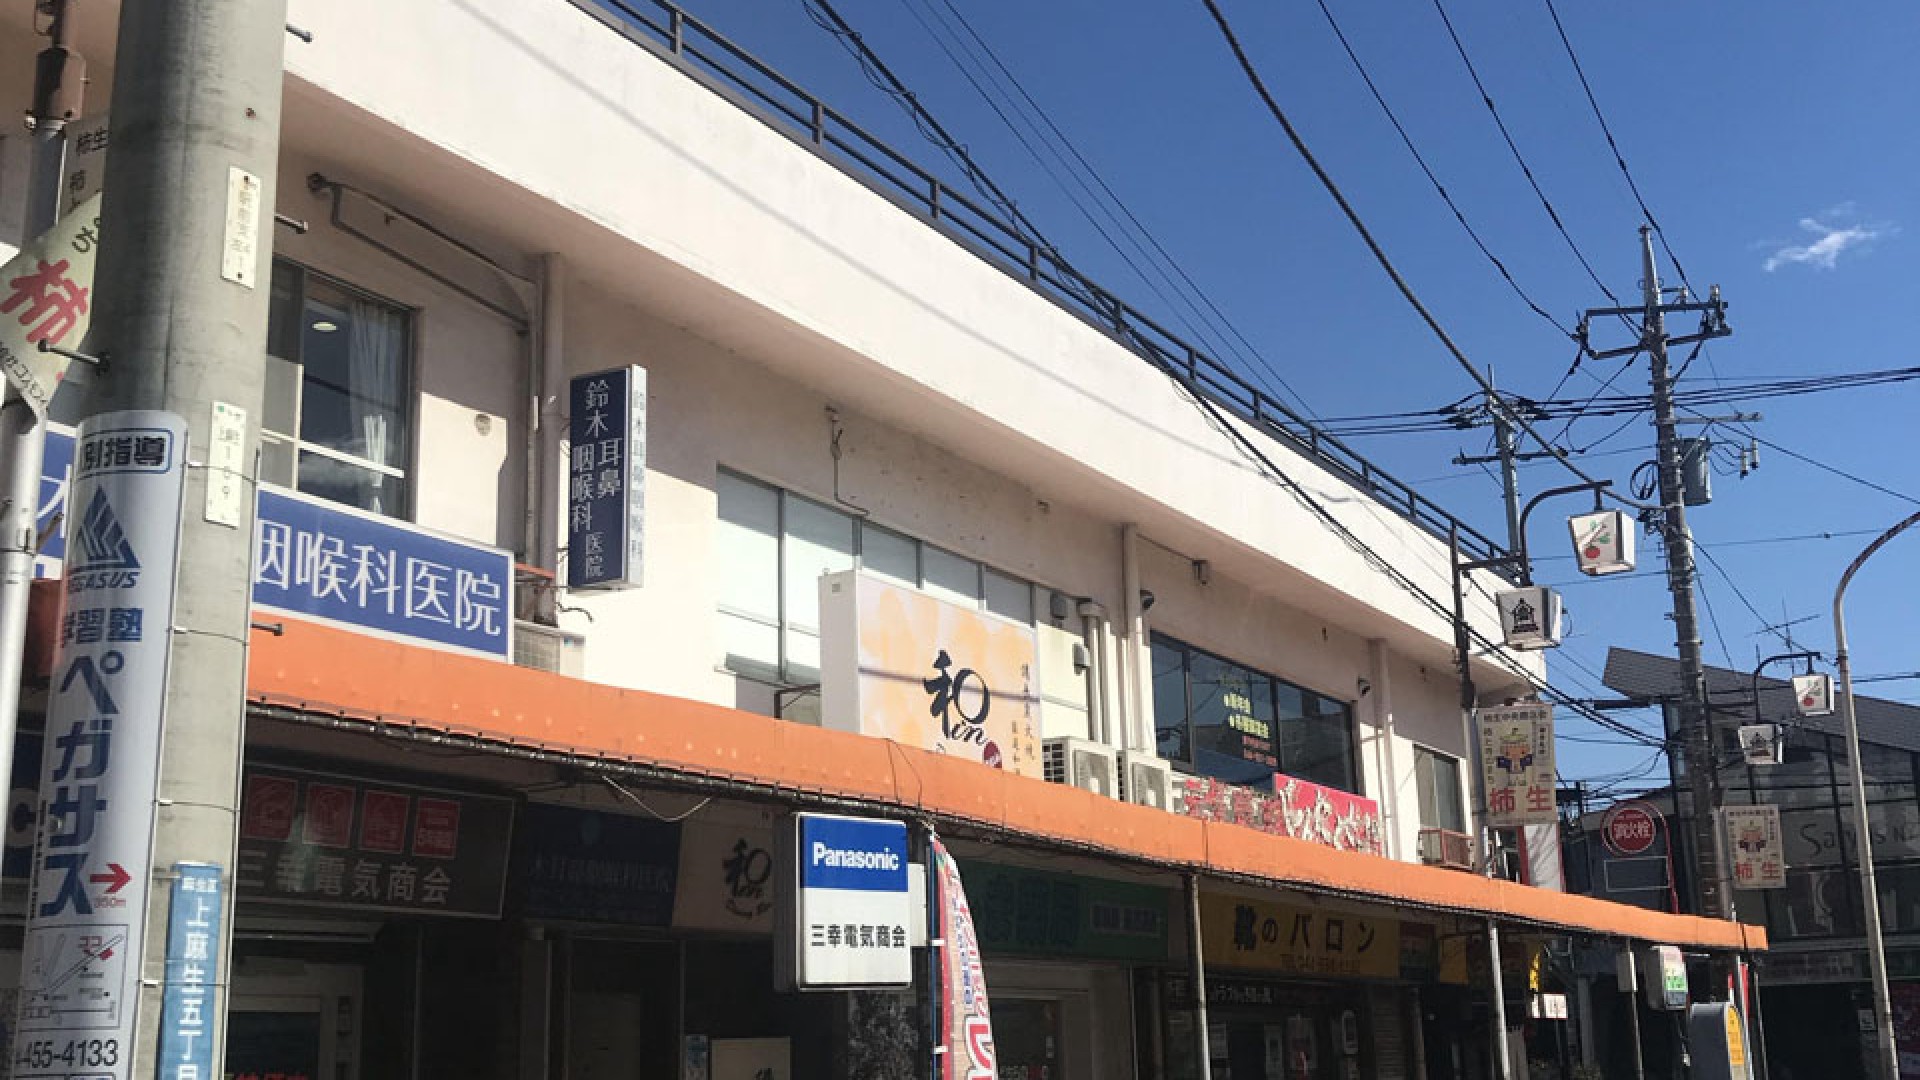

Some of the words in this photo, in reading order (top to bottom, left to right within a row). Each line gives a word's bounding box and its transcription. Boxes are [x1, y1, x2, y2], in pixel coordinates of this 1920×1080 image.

[0, 258, 91, 346] 柿
[585, 379, 609, 438] 鈴木
[571, 443, 595, 533] 咽喉科
[597, 437, 623, 499] 耳鼻
[923, 648, 991, 739] 和
[42, 652, 124, 915] ペガサス
[1489, 784, 1553, 813] 柿生
[812, 841, 899, 871] Panasonic
[1613, 820, 1651, 839] 消火栓
[237, 847, 452, 905] 三幸電気商会
[1734, 860, 1782, 882] 柿生
[811, 924, 907, 949] 三幸電気商会
